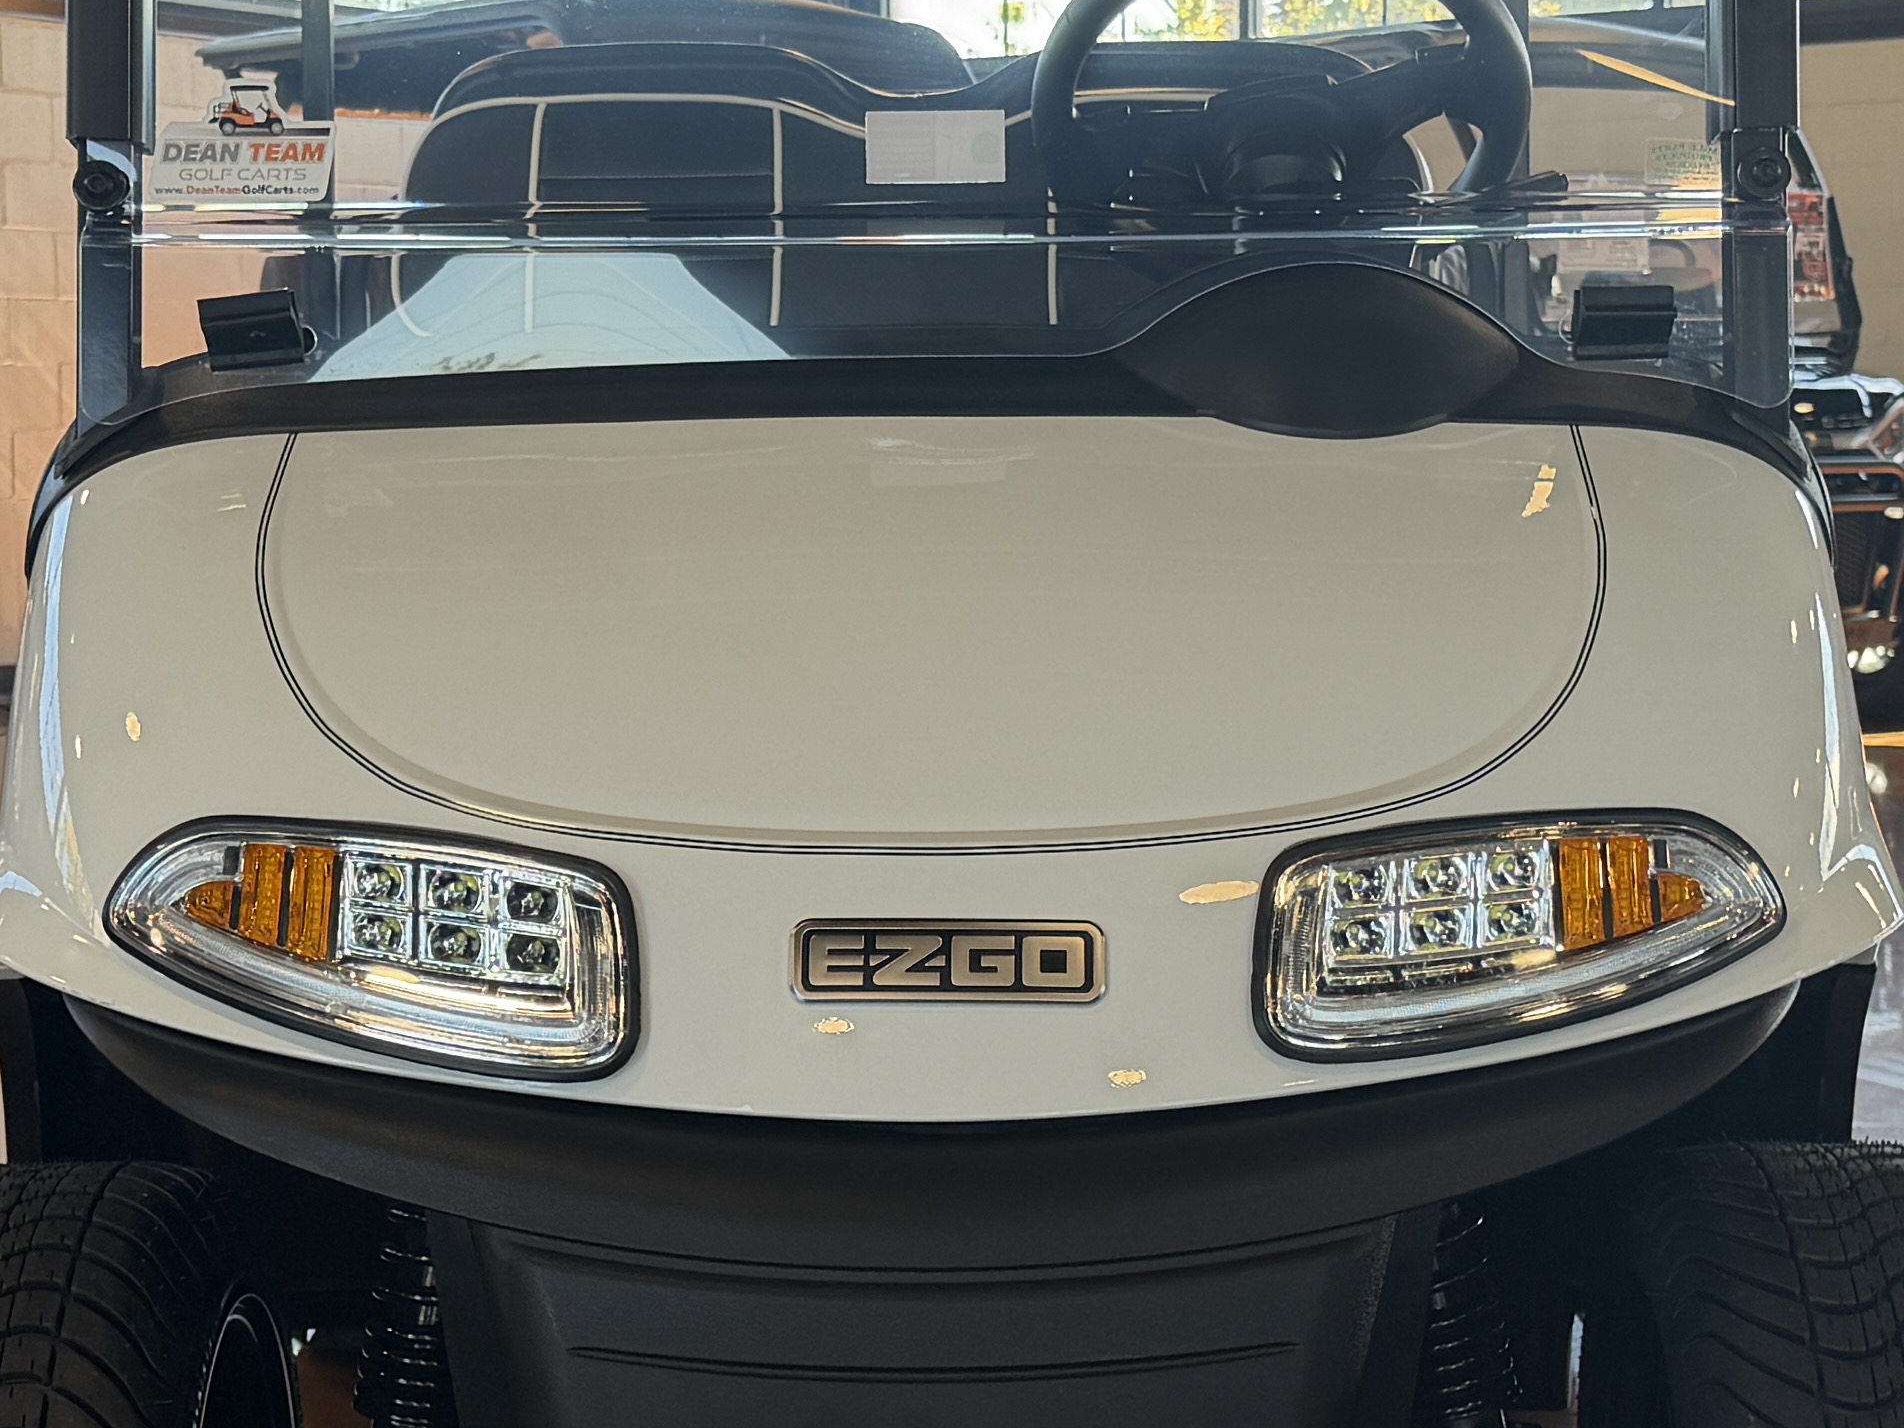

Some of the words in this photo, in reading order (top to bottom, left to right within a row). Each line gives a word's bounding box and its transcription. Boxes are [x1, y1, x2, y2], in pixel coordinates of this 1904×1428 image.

[162, 143, 240, 162] DEAN
[249, 143, 326, 162] TEAM
[179, 169, 232, 181] GOLF
[237, 169, 306, 181] CARTS
